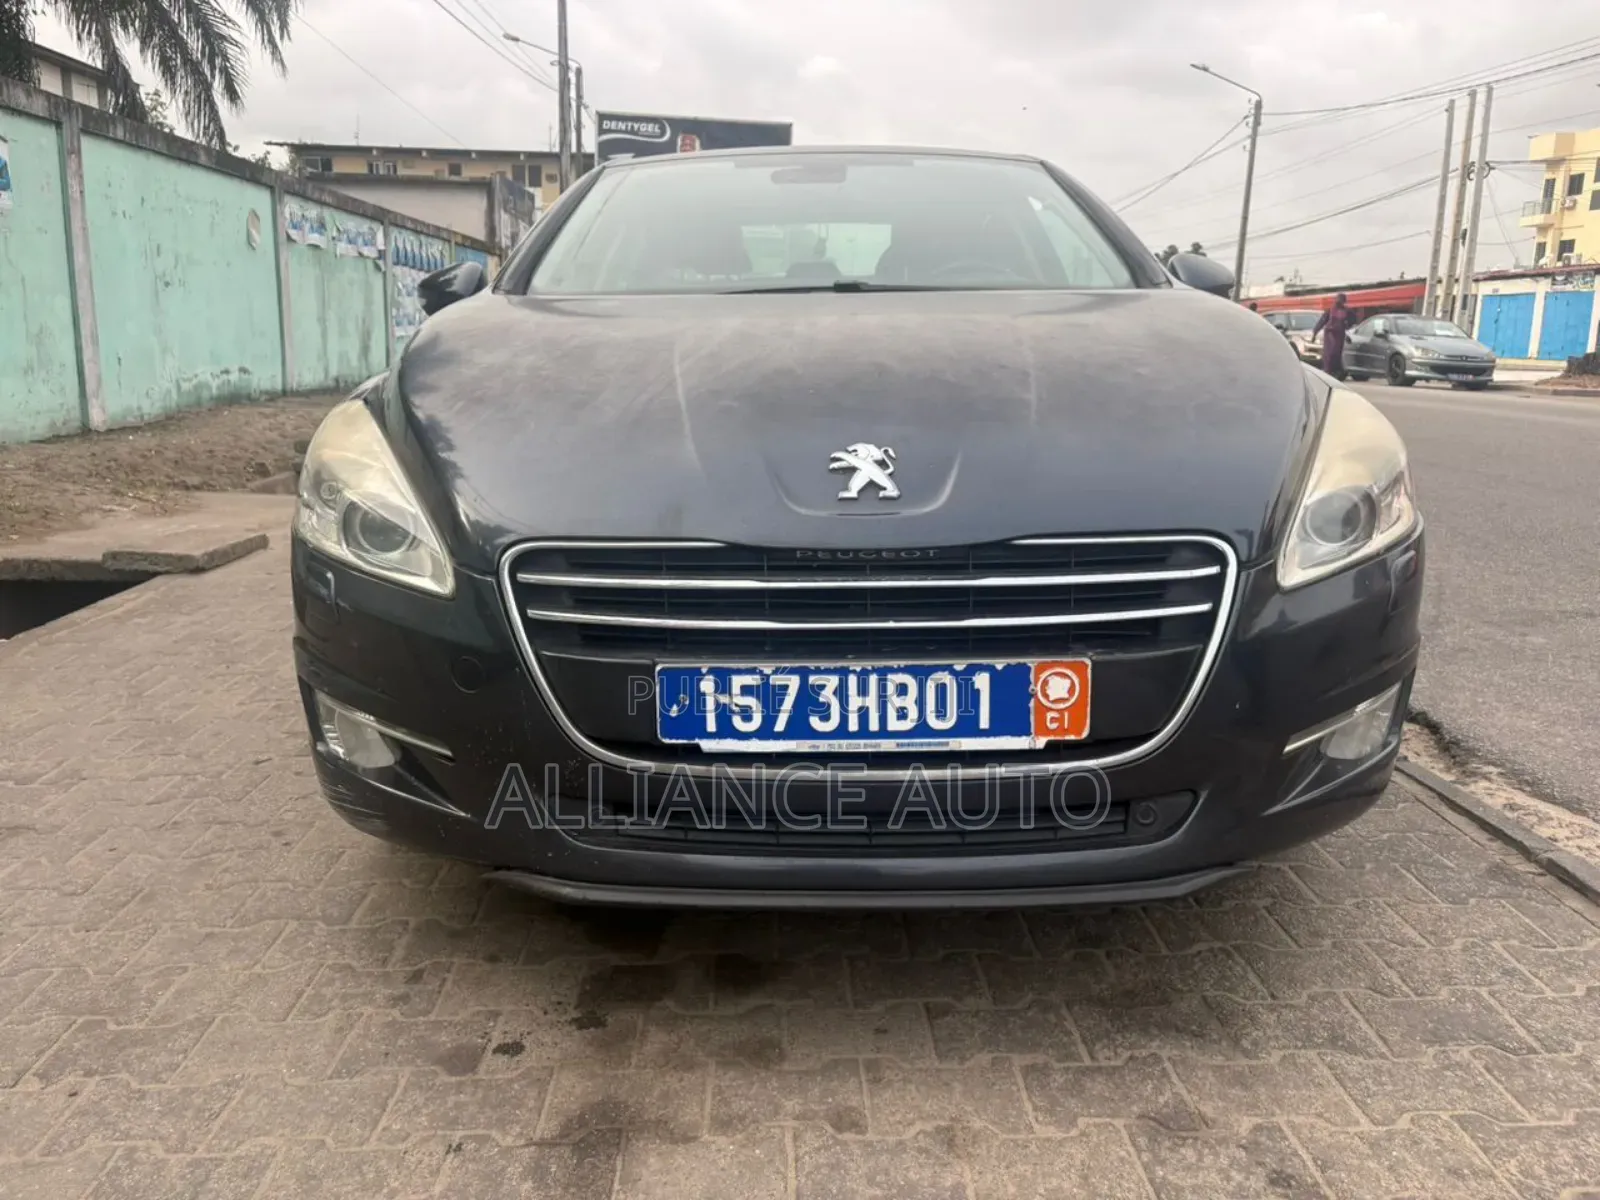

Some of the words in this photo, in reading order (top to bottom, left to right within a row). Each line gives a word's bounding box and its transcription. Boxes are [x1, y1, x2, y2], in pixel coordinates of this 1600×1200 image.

[602, 119, 661, 132] DENTYGEL
[700, 671, 990, 733] 1573HB01
[1045, 710, 1069, 730] CI
